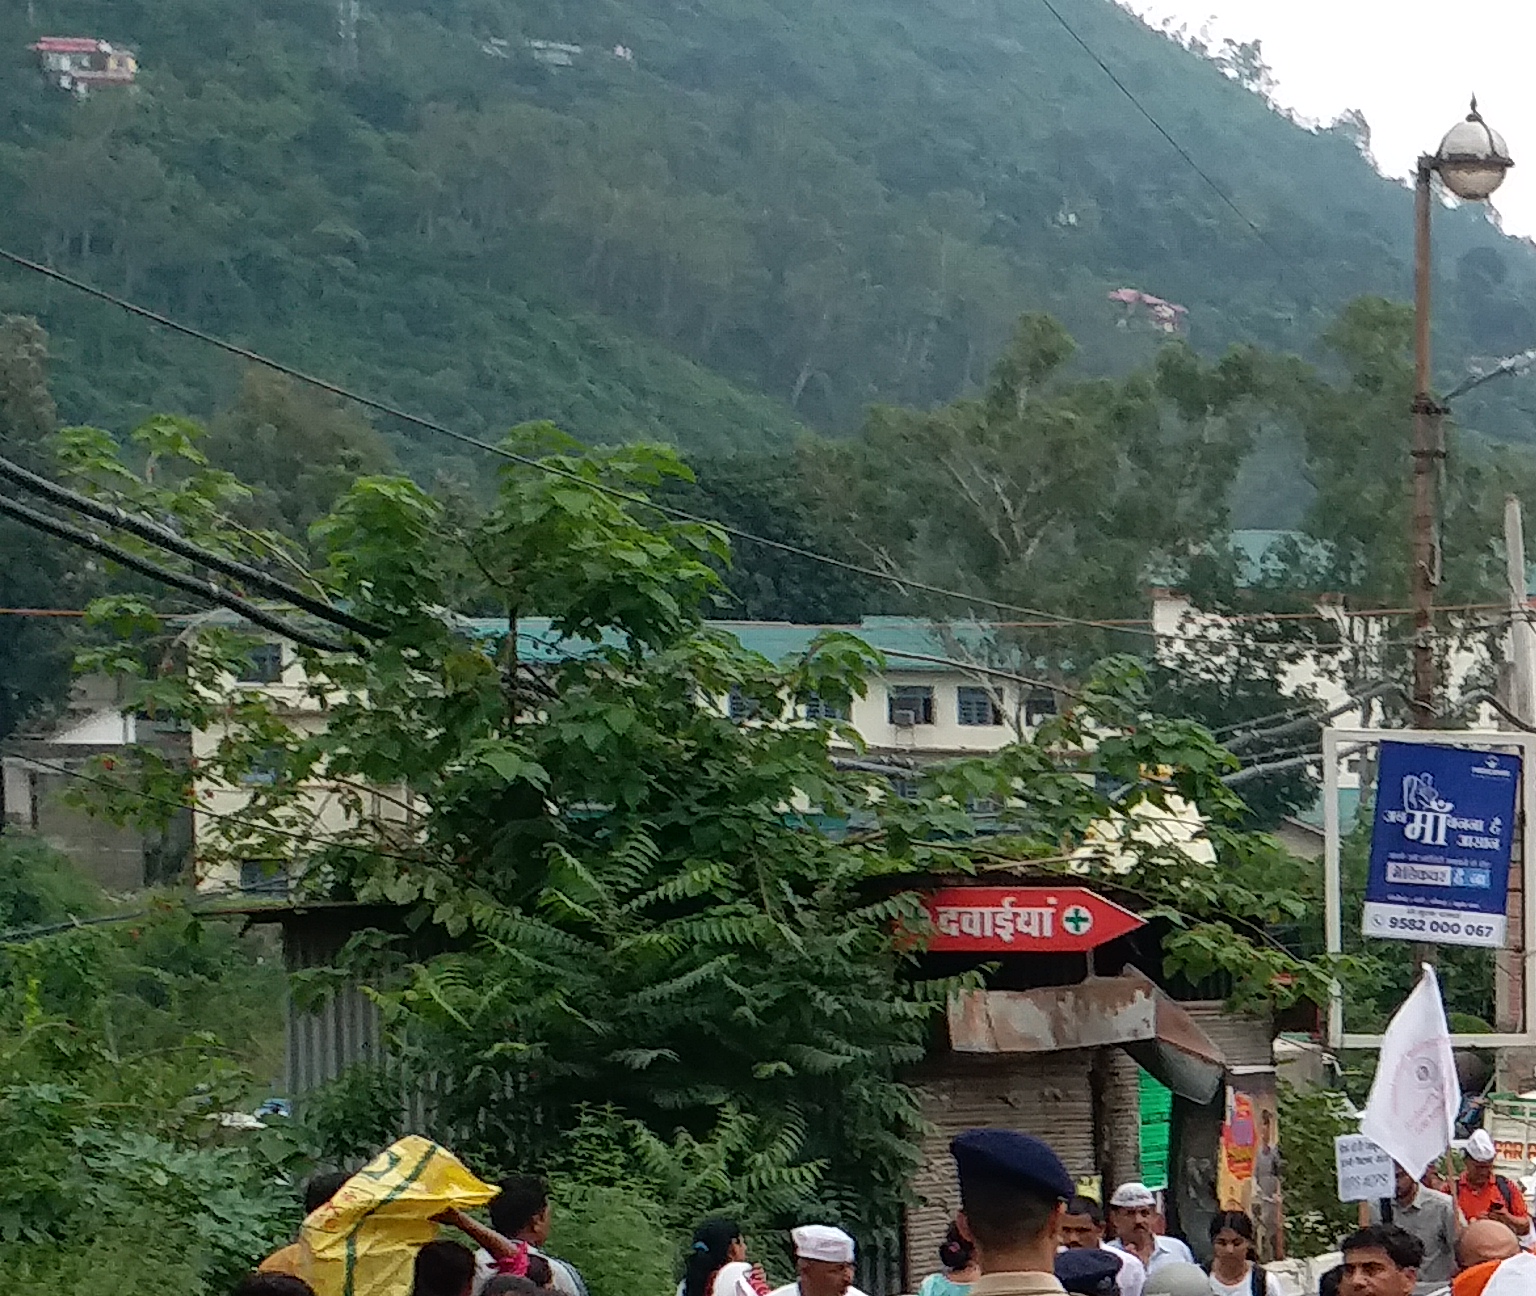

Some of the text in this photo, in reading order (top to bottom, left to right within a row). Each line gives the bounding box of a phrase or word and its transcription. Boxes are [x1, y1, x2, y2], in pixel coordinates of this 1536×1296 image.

[1388, 917, 1494, 938] 9582 000 067
